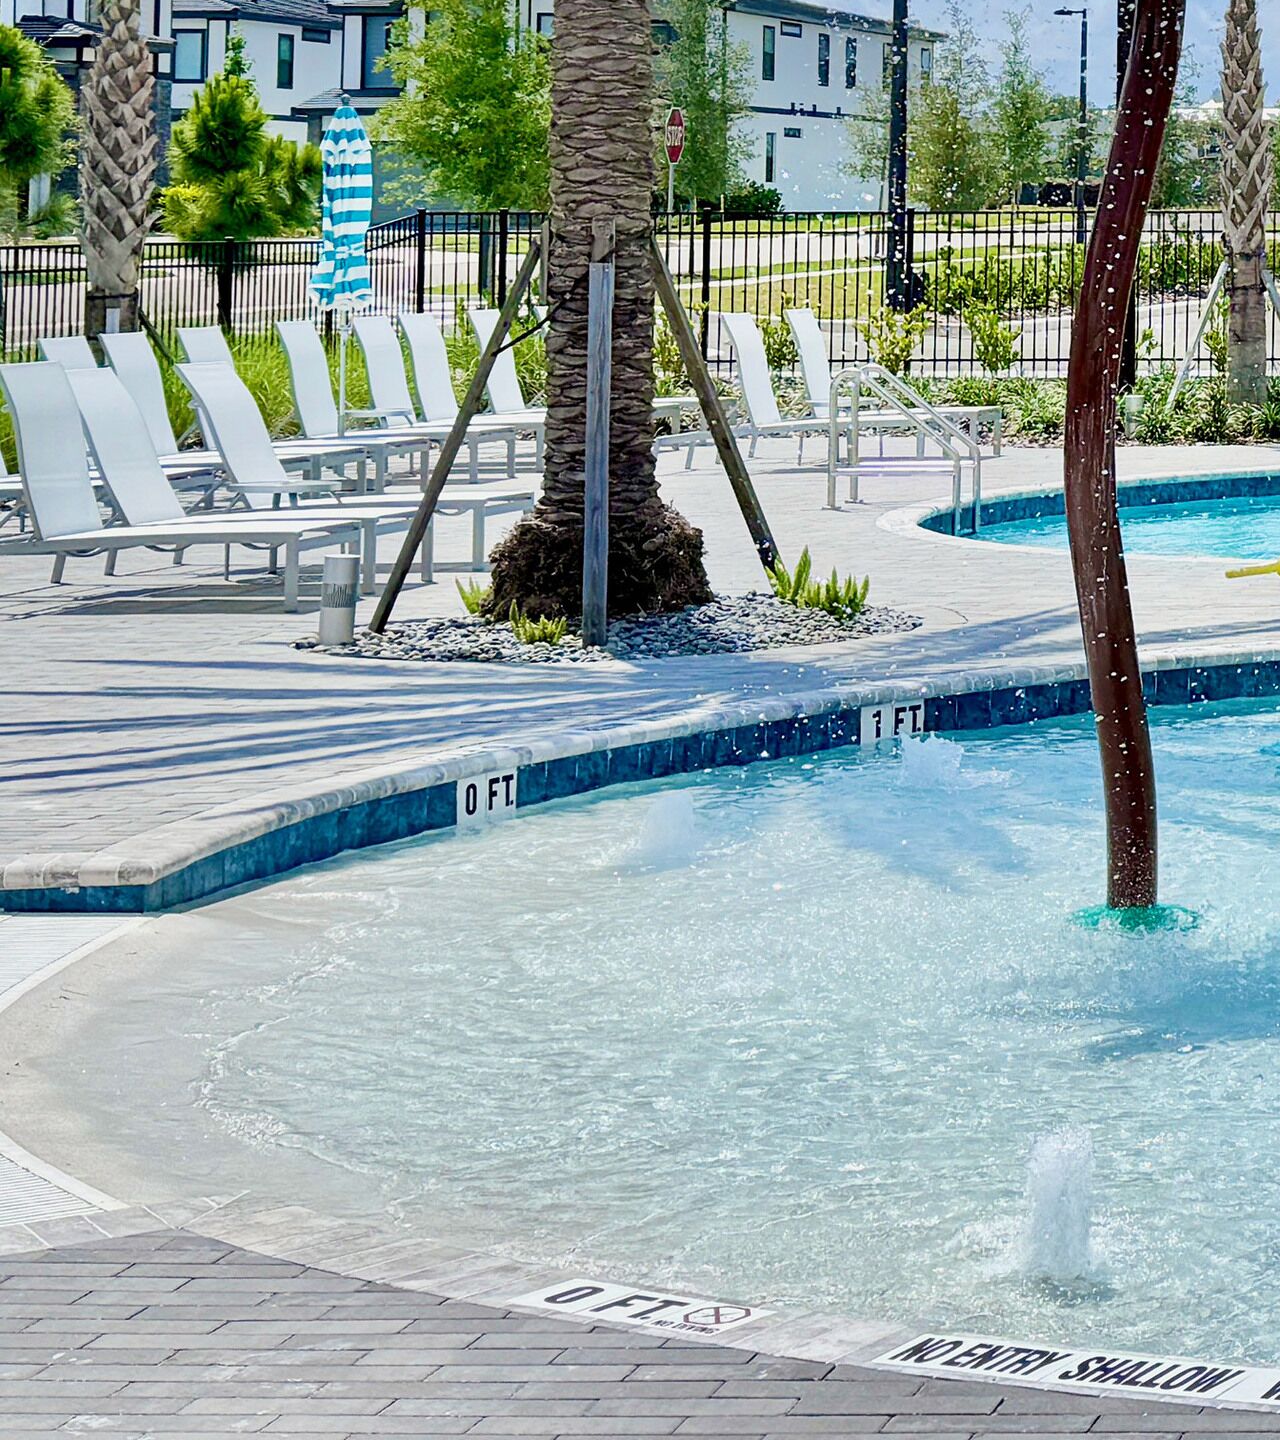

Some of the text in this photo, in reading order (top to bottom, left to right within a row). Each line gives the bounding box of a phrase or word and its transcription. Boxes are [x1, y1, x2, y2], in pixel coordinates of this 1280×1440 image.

[667, 125, 683, 147] STOP
[872, 704, 922, 738] 1 FT.
[465, 773, 515, 816] 0 FT.
[544, 1286, 691, 1320] 0 FT.
[652, 1319, 720, 1335] NO DIVING
[890, 1337, 963, 1364] NO
[942, 1343, 1073, 1376] ENTRY
[1058, 1356, 1244, 1393] SHALLOW
